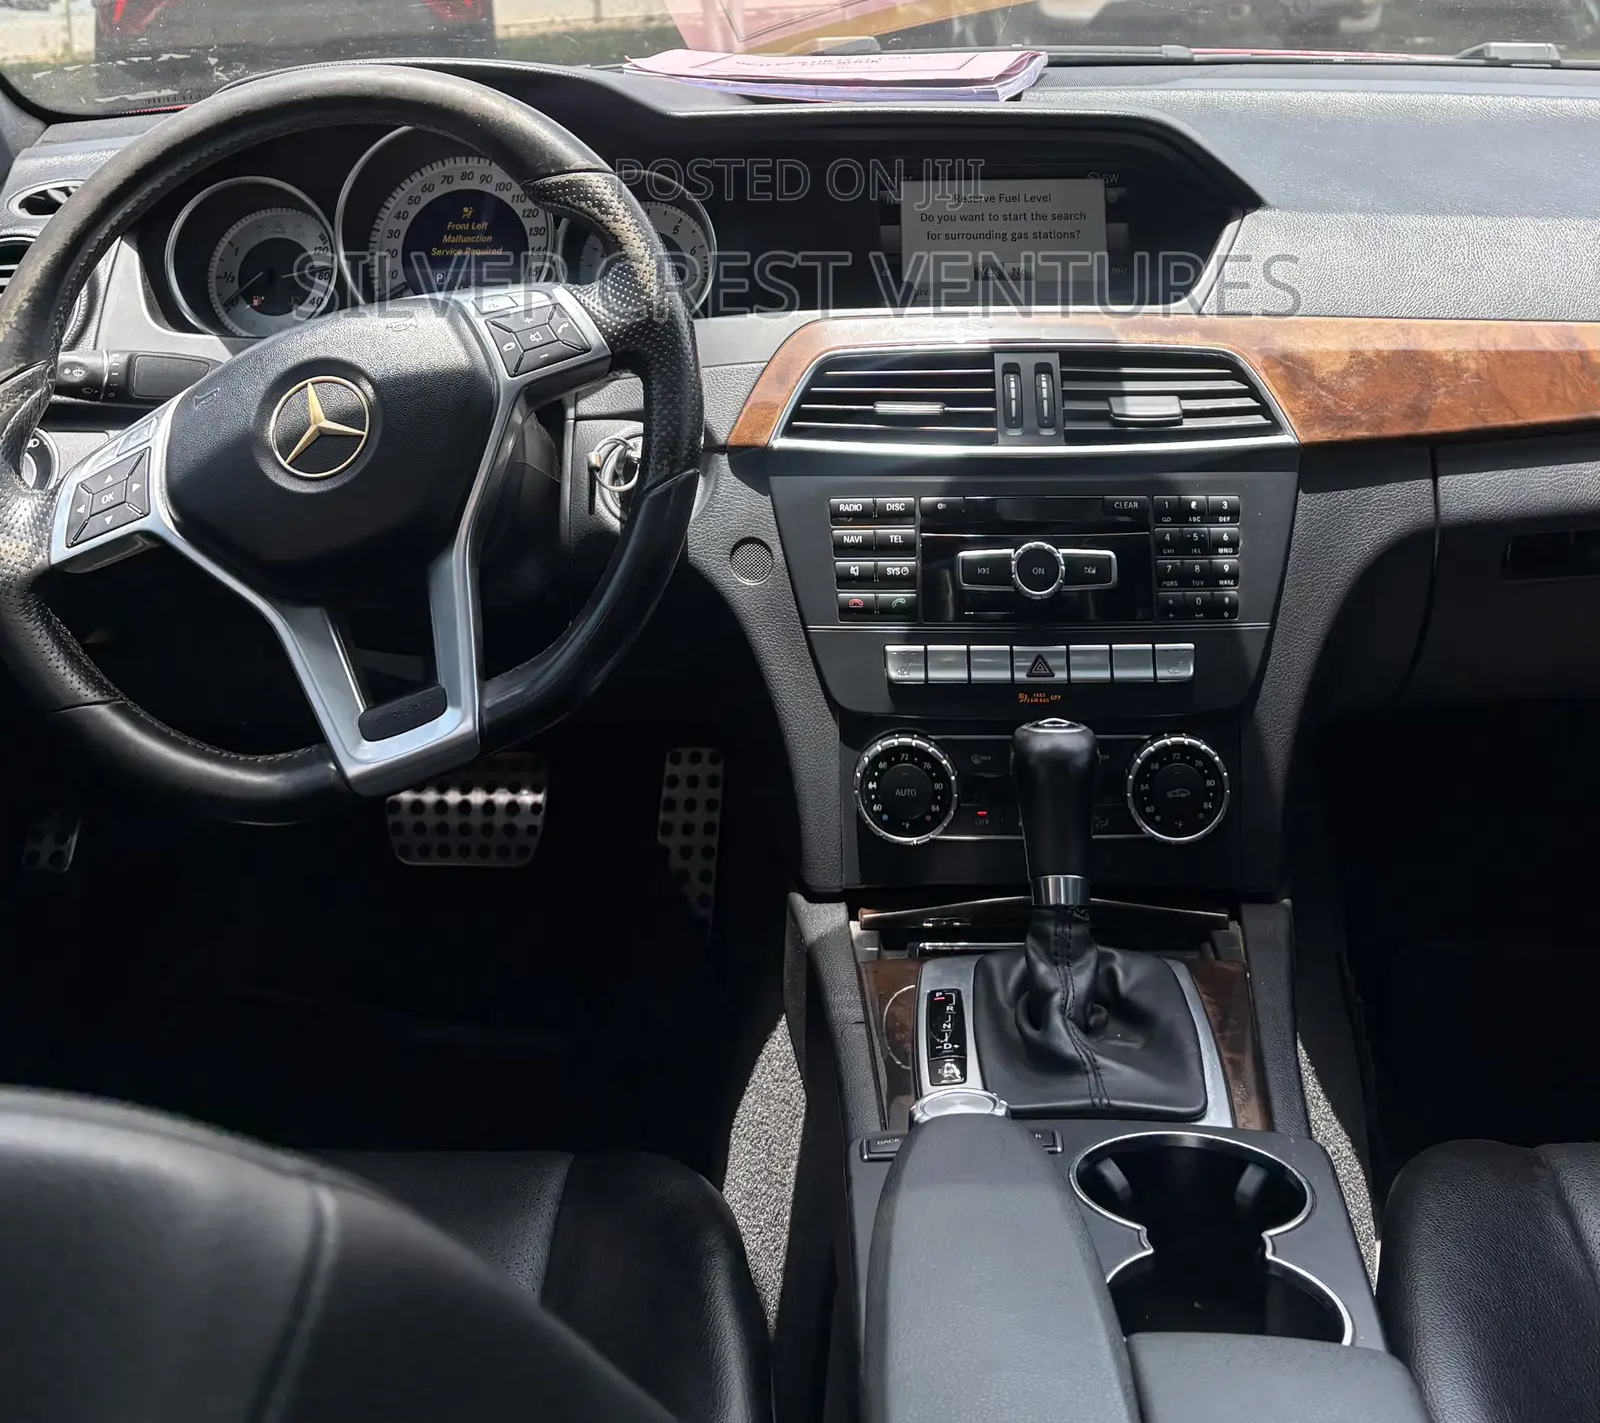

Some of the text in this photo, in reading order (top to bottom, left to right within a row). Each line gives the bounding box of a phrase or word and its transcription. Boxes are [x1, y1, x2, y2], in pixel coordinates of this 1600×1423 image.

[440, 174, 454, 185] 70
[460, 170, 475, 181] 80
[479, 174, 493, 184] 90
[420, 182, 435, 193] 60
[494, 182, 513, 192] 100
[407, 195, 421, 206] 50
[510, 193, 527, 204] 110
[953, 192, 1052, 204] Reserve Fuel Level
[393, 210, 409, 221] 40
[521, 208, 539, 219] 120
[920, 210, 1086, 225] Do you want to start the search
[447, 221, 488, 231] Front Left
[672, 225, 680, 235] 5
[386, 229, 401, 240] 30
[529, 226, 546, 237] 130
[926, 228, 1081, 243] for surrounding gas stations?
[442, 234, 493, 244] Malfunction
[431, 246, 504, 258] Service Required
[690, 245, 698, 256] 6
[318, 271, 331, 281] 80
[980, 266, 999, 277] Yes
[308, 296, 323, 307] 40
[101, 490, 115, 505] OK
[839, 503, 863, 512] RADIO
[886, 502, 906, 511] DISC
[1113, 501, 1139, 510] CLEAR
[1221, 500, 1228, 510] 3
[843, 535, 863, 544] NAVI
[889, 534, 904, 544] TEL
[886, 567, 901, 576] SYS
[1031, 567, 1045, 575] ON
[900, 753, 909, 761] 72
[1171, 752, 1181, 760] 72
[878, 761, 888, 769] 68
[1150, 762, 1160, 770] 68
[1194, 759, 1204, 767] 76
[867, 781, 877, 790] 64
[934, 782, 944, 790] 80
[1140, 783, 1150, 791] 64
[1205, 779, 1216, 787] 80
[894, 788, 917, 797] AUTO
[872, 803, 883, 812] 60
[930, 804, 940, 812] 84
[1145, 805, 1155, 813] 60
[1203, 801, 1213, 809] 84
[974, 818, 989, 826] OFF
